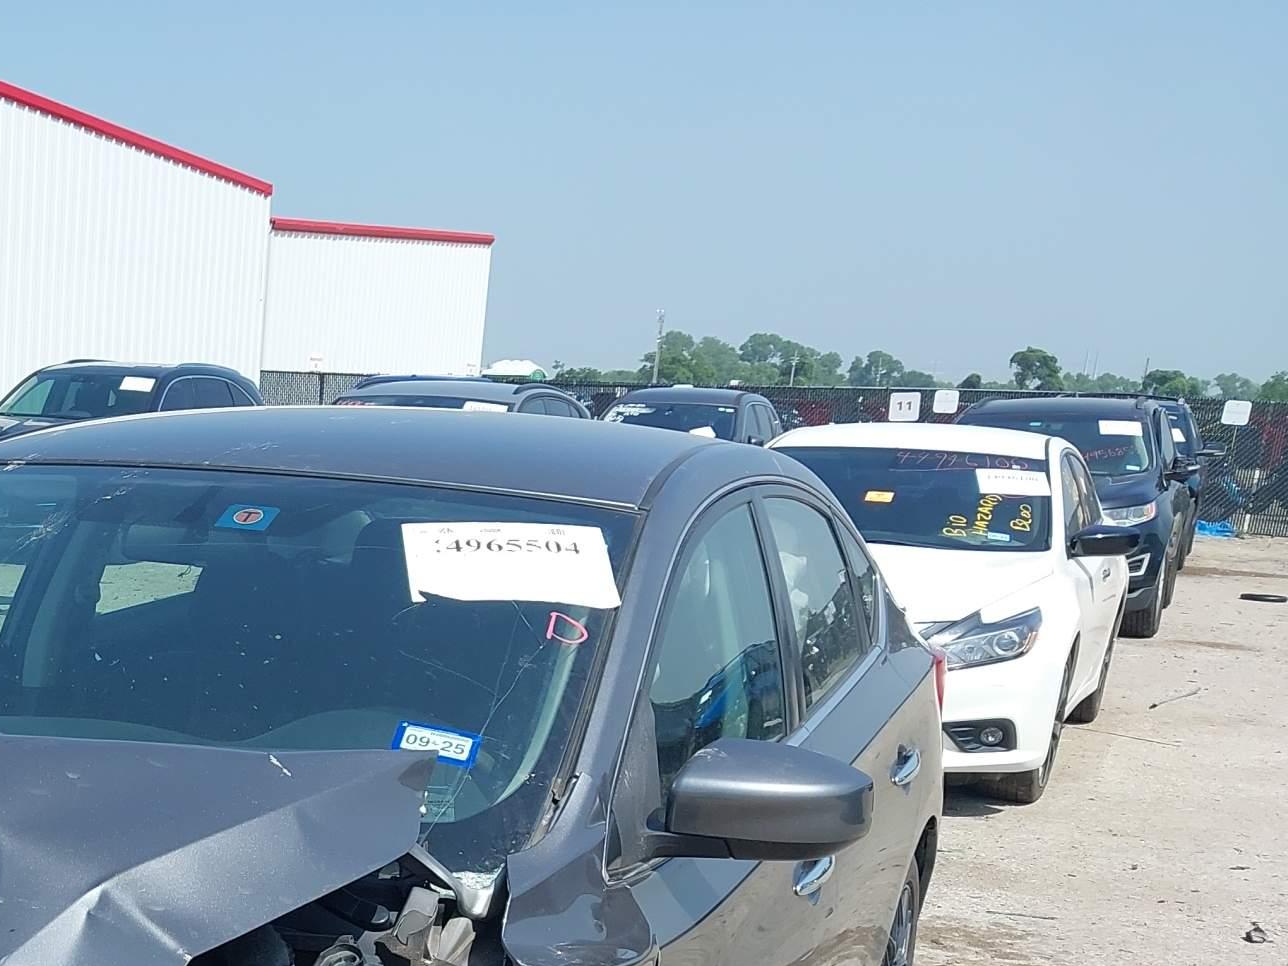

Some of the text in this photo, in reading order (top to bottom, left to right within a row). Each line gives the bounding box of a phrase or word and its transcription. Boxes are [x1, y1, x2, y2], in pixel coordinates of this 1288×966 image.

[897, 401, 912, 411] 11
[546, 611, 589, 644] D
[405, 733, 466, 755] 09-25
